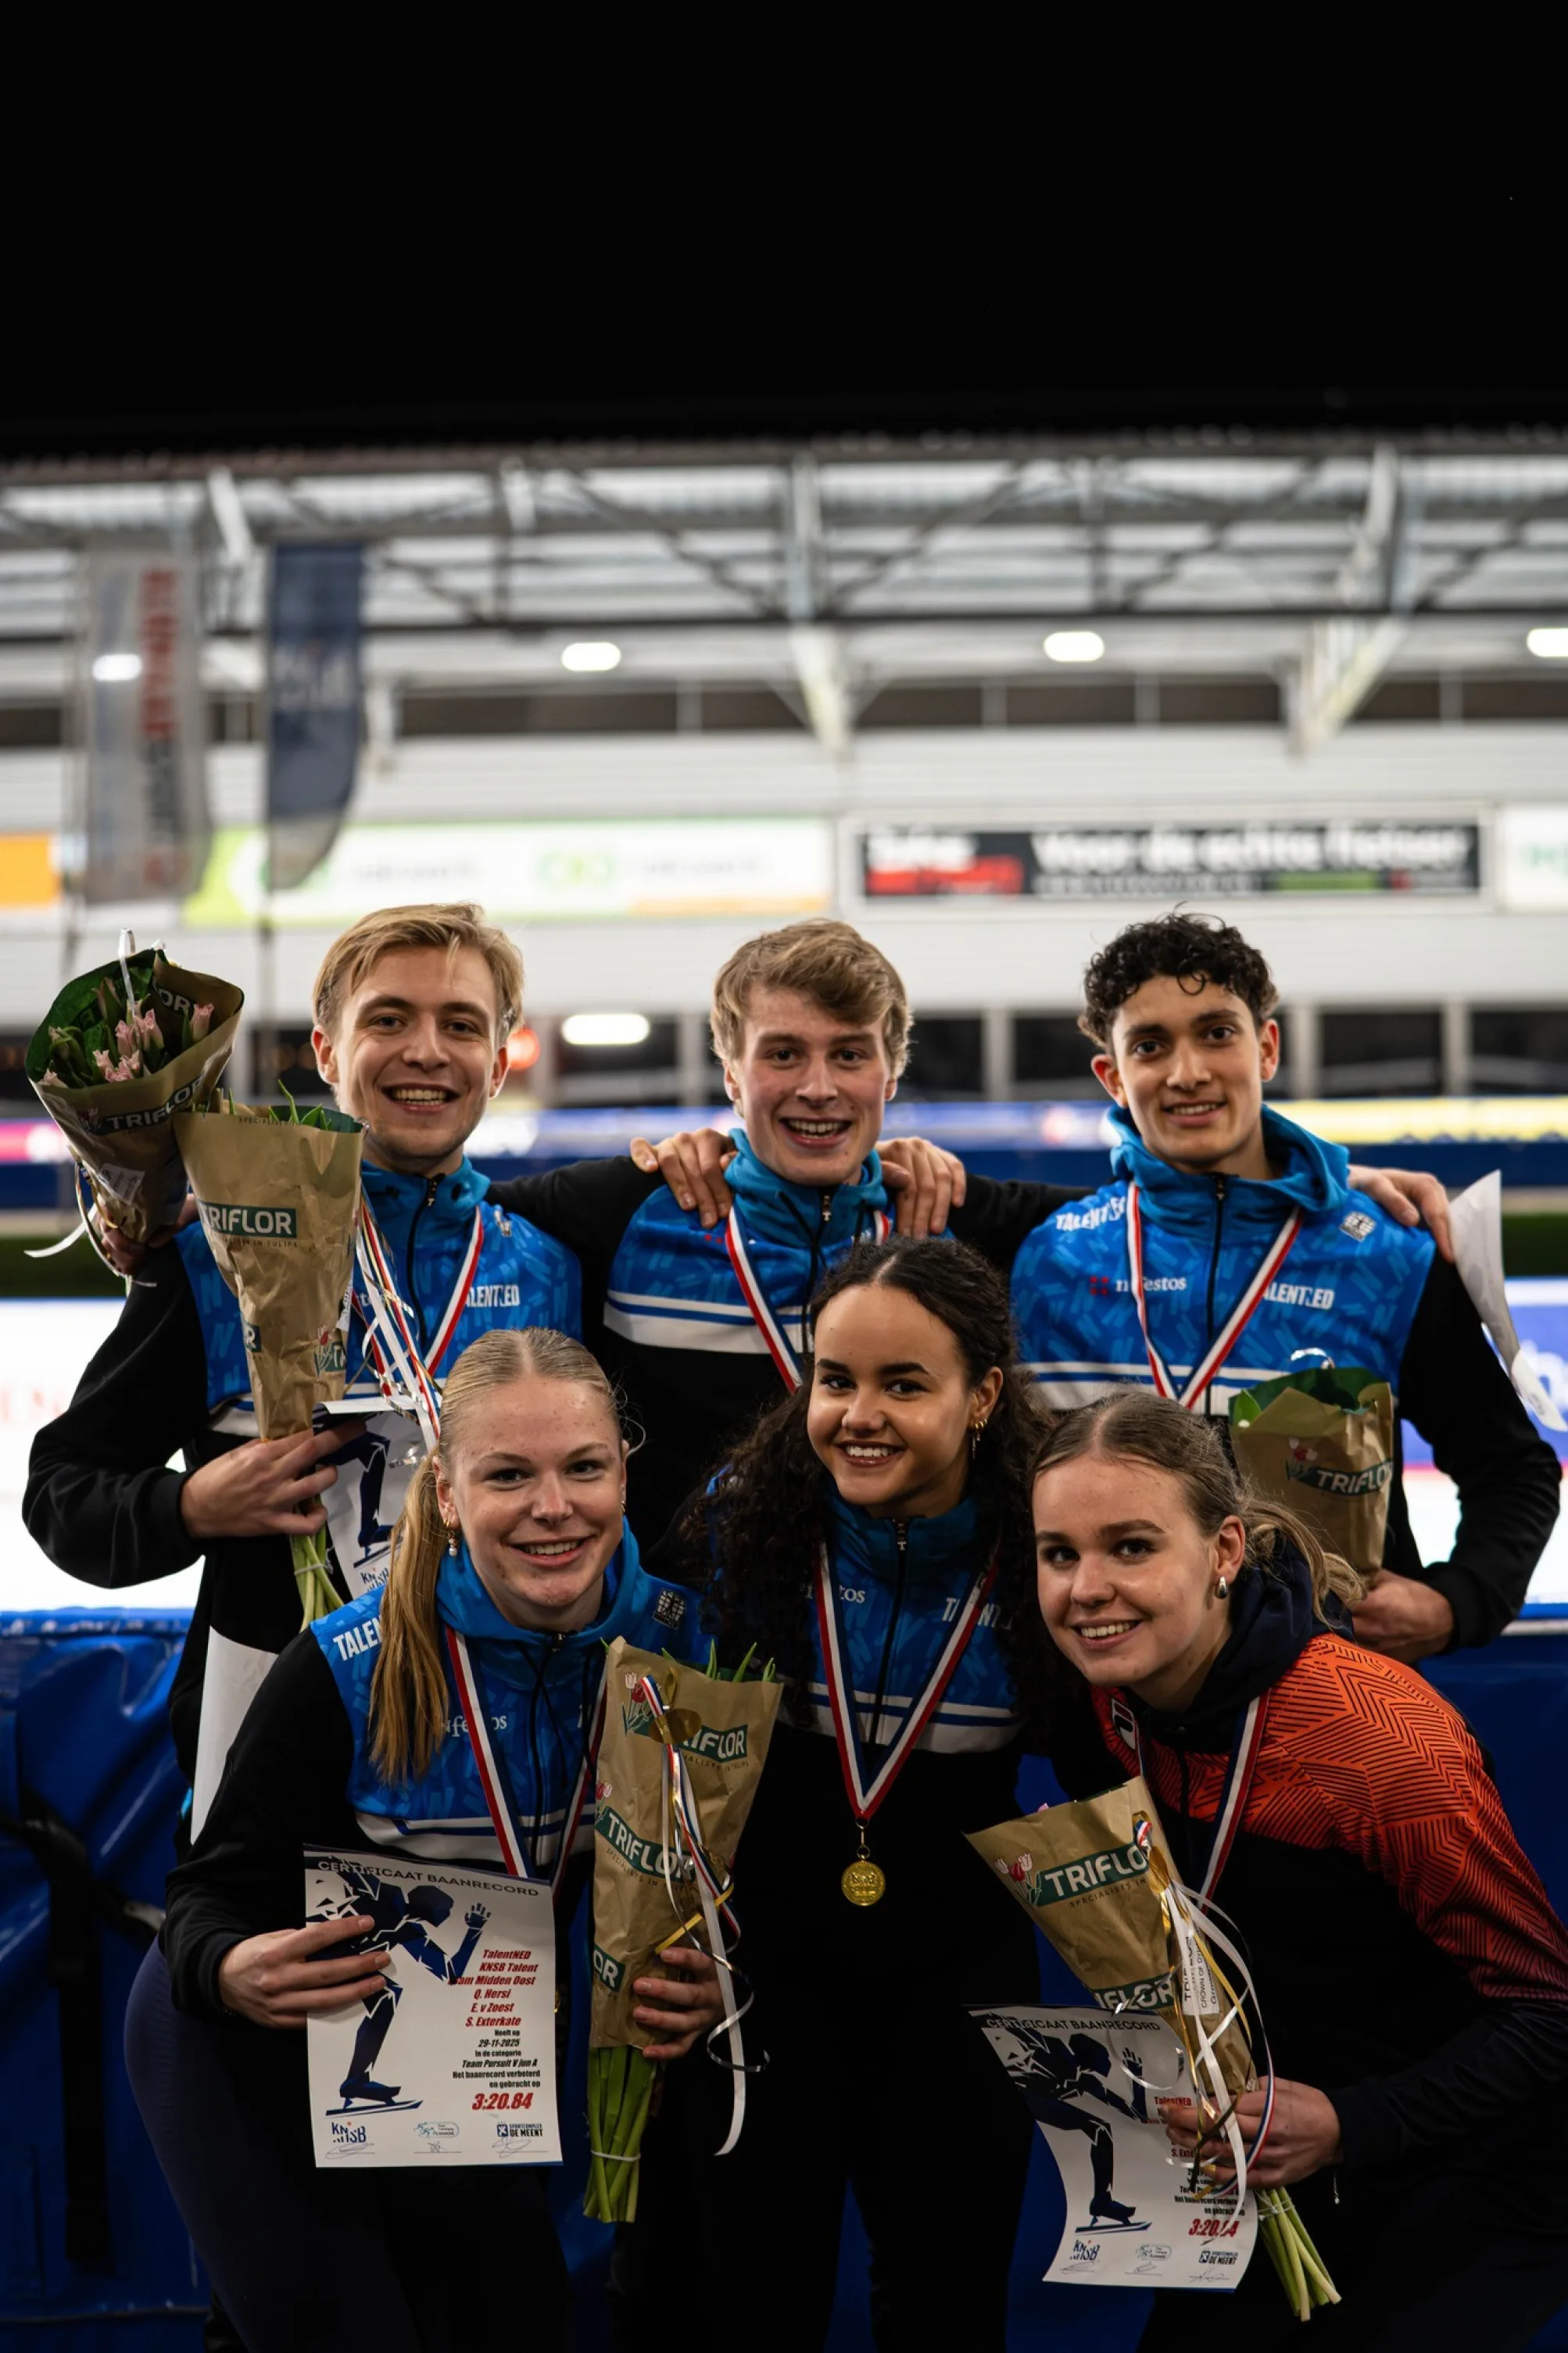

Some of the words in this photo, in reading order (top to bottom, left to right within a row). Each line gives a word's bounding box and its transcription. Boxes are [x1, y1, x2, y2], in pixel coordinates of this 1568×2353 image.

[1044, 1846, 1147, 1896] TRIFLO
[427, 1874, 539, 1896] BAANRECORD
[471, 2092, 533, 2111] 3:20.84
